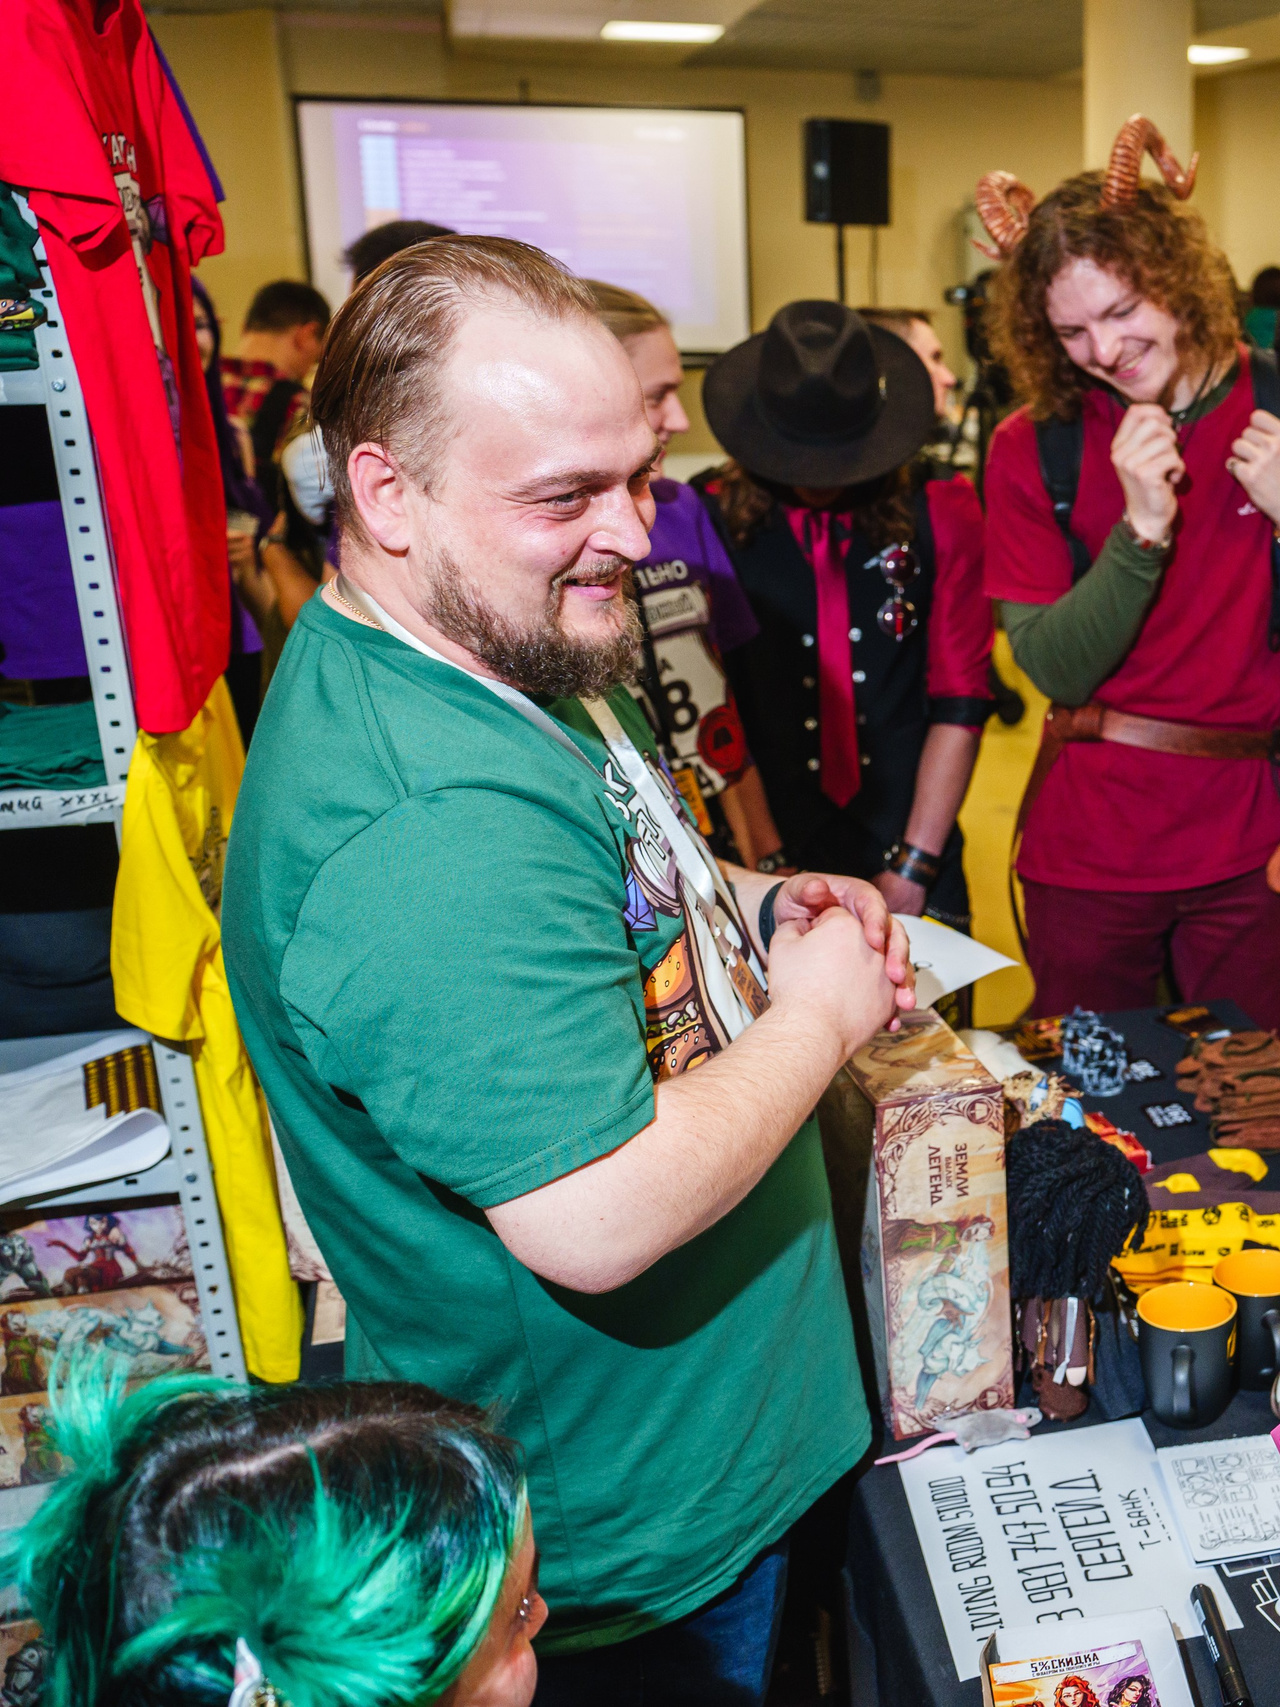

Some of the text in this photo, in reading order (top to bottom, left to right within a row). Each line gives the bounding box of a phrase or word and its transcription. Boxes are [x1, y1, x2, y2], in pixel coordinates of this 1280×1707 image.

[927, 1144, 943, 1208] ЛЕГЕНД
[955, 1143, 969, 1198] ЗЕМЛИ
[928, 1476, 974, 1522] STUDIO
[942, 1522, 987, 1573] ROOM
[1001, 1520, 1057, 1562] 747
[1051, 1496, 1134, 1582] СЕРГЕЙ
[1017, 1561, 1074, 1604] 981
